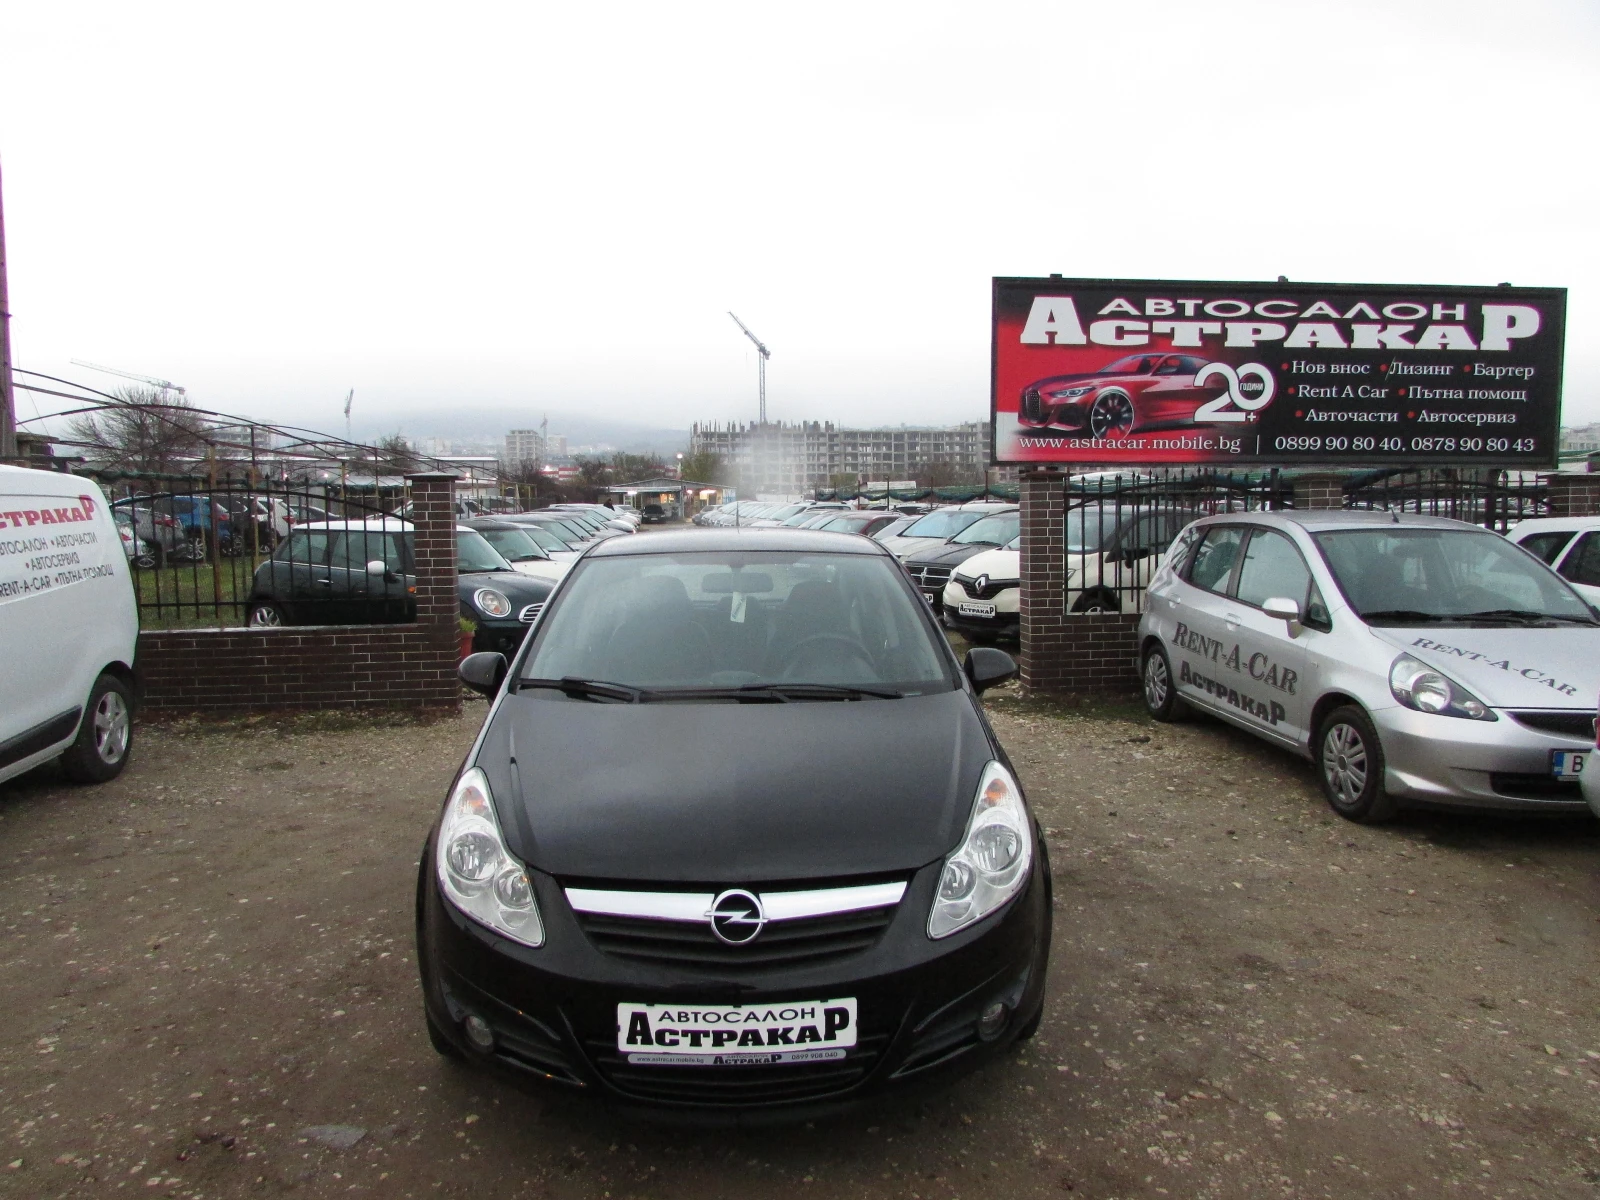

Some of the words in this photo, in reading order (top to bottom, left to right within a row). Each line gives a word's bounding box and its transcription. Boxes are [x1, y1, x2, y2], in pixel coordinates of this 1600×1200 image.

[1097, 298, 1466, 320] АВТОСАЛОН
[1020, 296, 1540, 351] АСТРАКАР
[1291, 360, 1326, 374] Нов
[1330, 363, 1370, 374] внос
[1388, 362, 1454, 376] Лизинг
[1473, 363, 1535, 380] Бартер
[1240, 382, 1264, 392] ГОДИНИ
[1298, 385, 1338, 398] Rent
[1342, 385, 1355, 398] A
[1358, 385, 1389, 399] Car
[1408, 386, 1463, 399] Пътна
[1468, 389, 1527, 402] помощ
[1305, 408, 1398, 423] Авточасти
[1417, 409, 1516, 426] Автосервиз
[1020, 434, 1241, 454] www.astracar.mobile.bg
[1275, 436, 1321, 451] 0899
[1325, 436, 1348, 451] 90
[1352, 436, 1375, 451] 80
[1411, 437, 1455, 452] 0878
[1459, 437, 1482, 452] 90
[1486, 437, 1508, 452] 80
[1512, 438, 1535, 452] 43
[1171, 621, 1298, 696] RENT-A-CAR
[1410, 637, 1579, 697] RENT-A-CAR
[1180, 660, 1287, 727] АСТРАКАР
[658, 1007, 816, 1023] АВТОСАЛОН
[626, 1006, 850, 1048] АСТРАКАР
